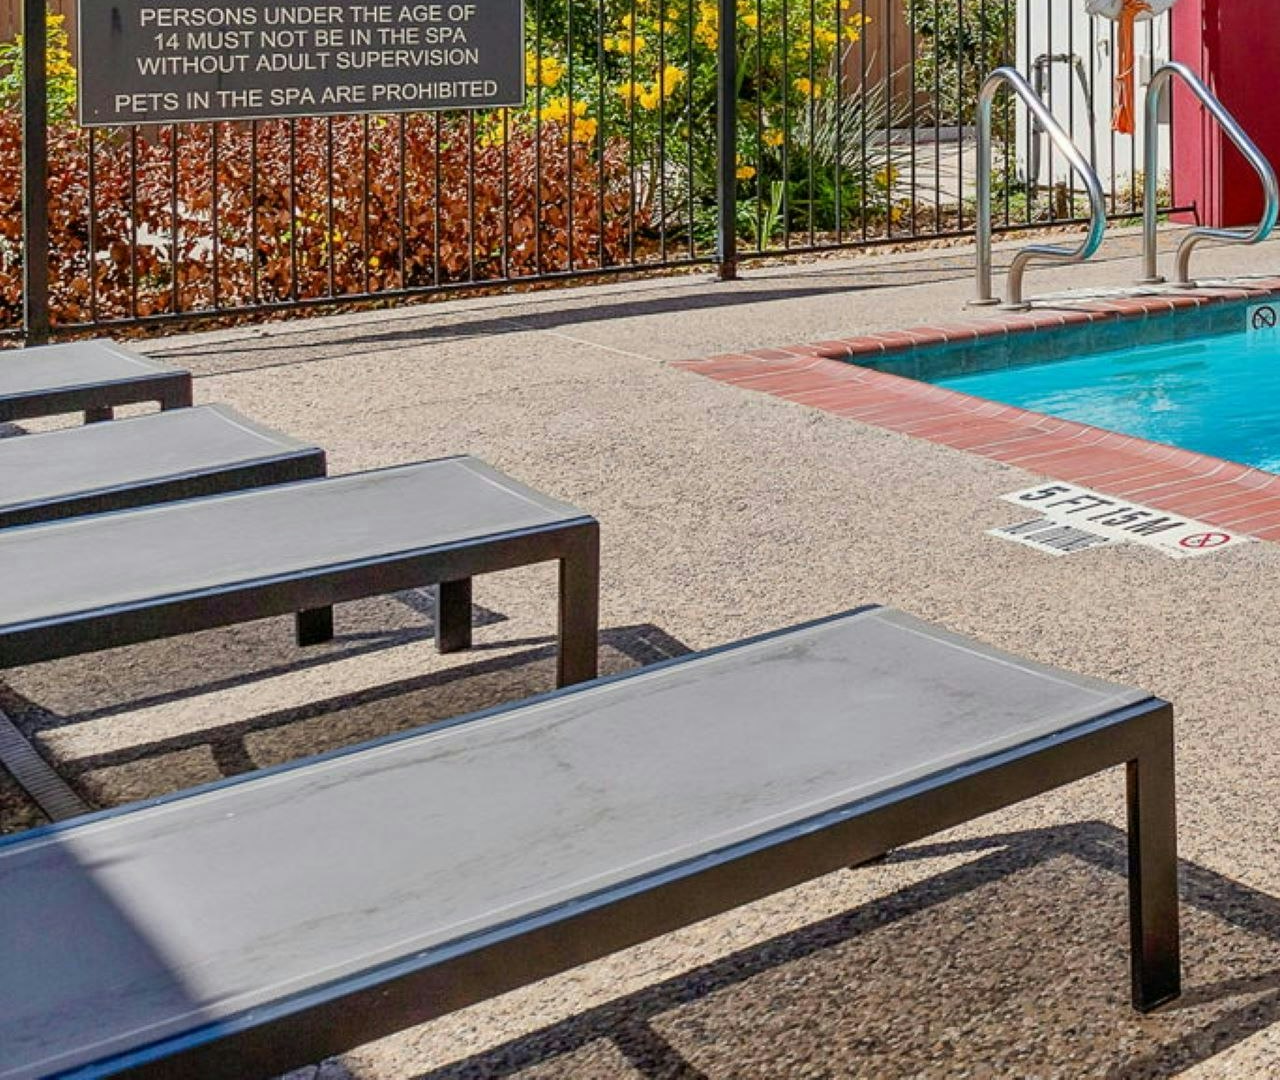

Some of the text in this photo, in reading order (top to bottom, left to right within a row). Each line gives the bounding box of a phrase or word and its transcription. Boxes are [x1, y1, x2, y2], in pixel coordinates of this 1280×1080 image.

[140, 4, 476, 27] PERSONS UNDER THE AGE OF
[154, 27, 467, 51] 14 MUST NOT BE IN THE SPA
[136, 48, 479, 76] WITHOUT ADULT SUPERVISION
[115, 80, 498, 113] PETS IN THE SPA ARE PROHIBITED
[1019, 486, 1071, 501] 5
[1045, 494, 1114, 515] FT
